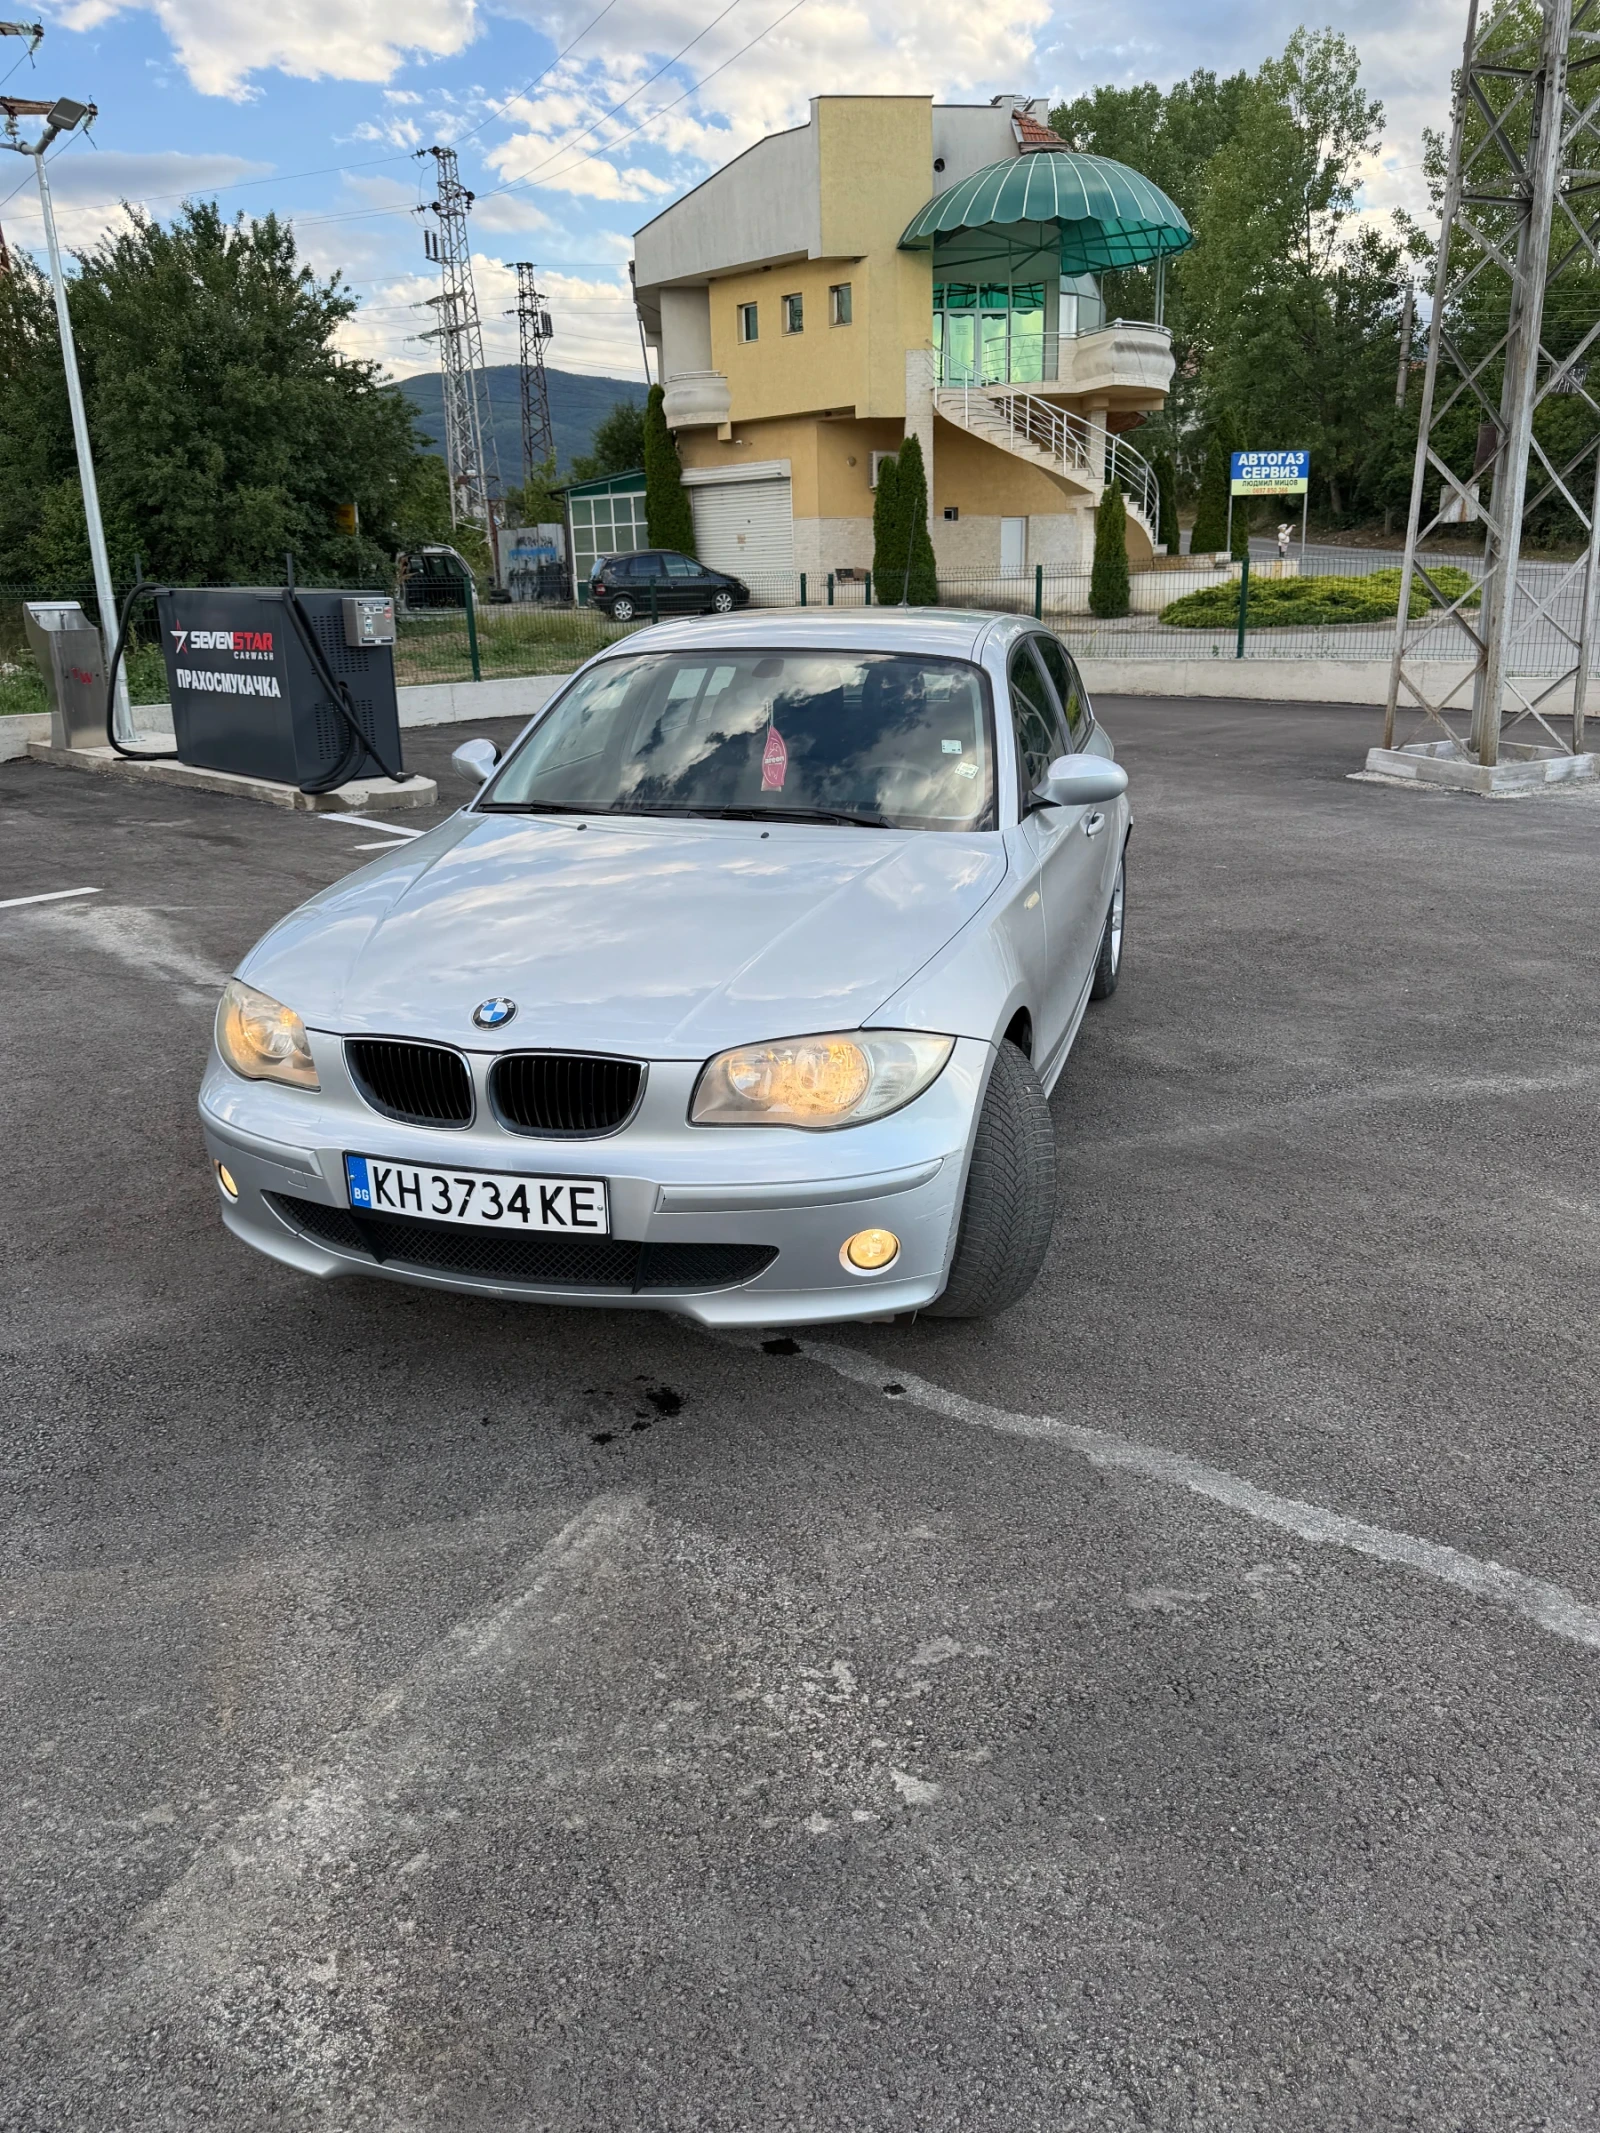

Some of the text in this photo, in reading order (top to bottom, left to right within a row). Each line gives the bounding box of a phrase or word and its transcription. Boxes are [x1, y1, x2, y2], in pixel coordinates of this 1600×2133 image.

[1238, 453, 1304, 466] АВТОГАЗ
[1242, 466, 1299, 479] СЕРВИЗ
[233, 651, 274, 661] CARWASH
[176, 668, 282, 698] ПРАХОСМУКАЧКА
[353, 1187, 370, 1201] BG
